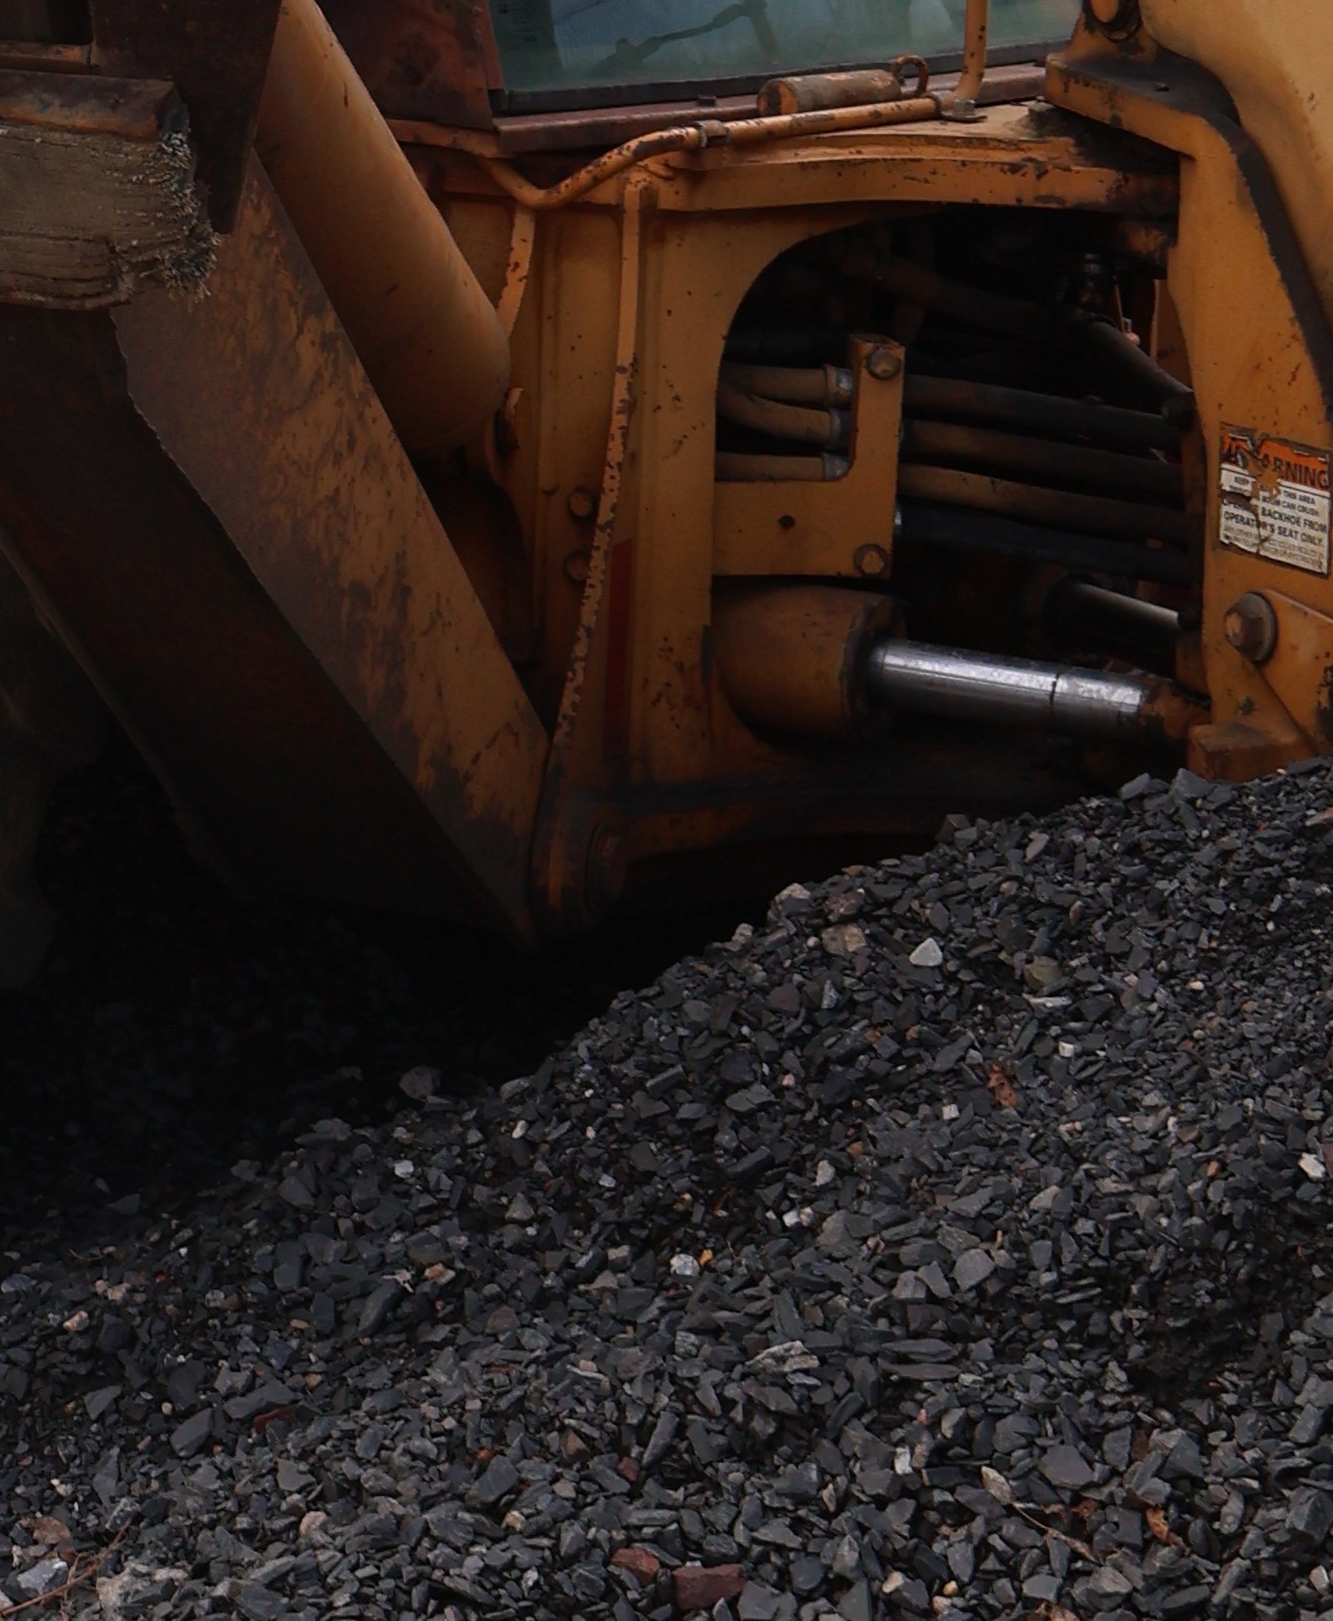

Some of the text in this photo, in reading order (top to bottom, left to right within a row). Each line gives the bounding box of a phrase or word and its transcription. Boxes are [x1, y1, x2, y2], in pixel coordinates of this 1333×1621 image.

[1260, 506, 1302, 528] BACKHOE
[1303, 518, 1328, 535] FROM
[1276, 526, 1299, 541] SEAT
